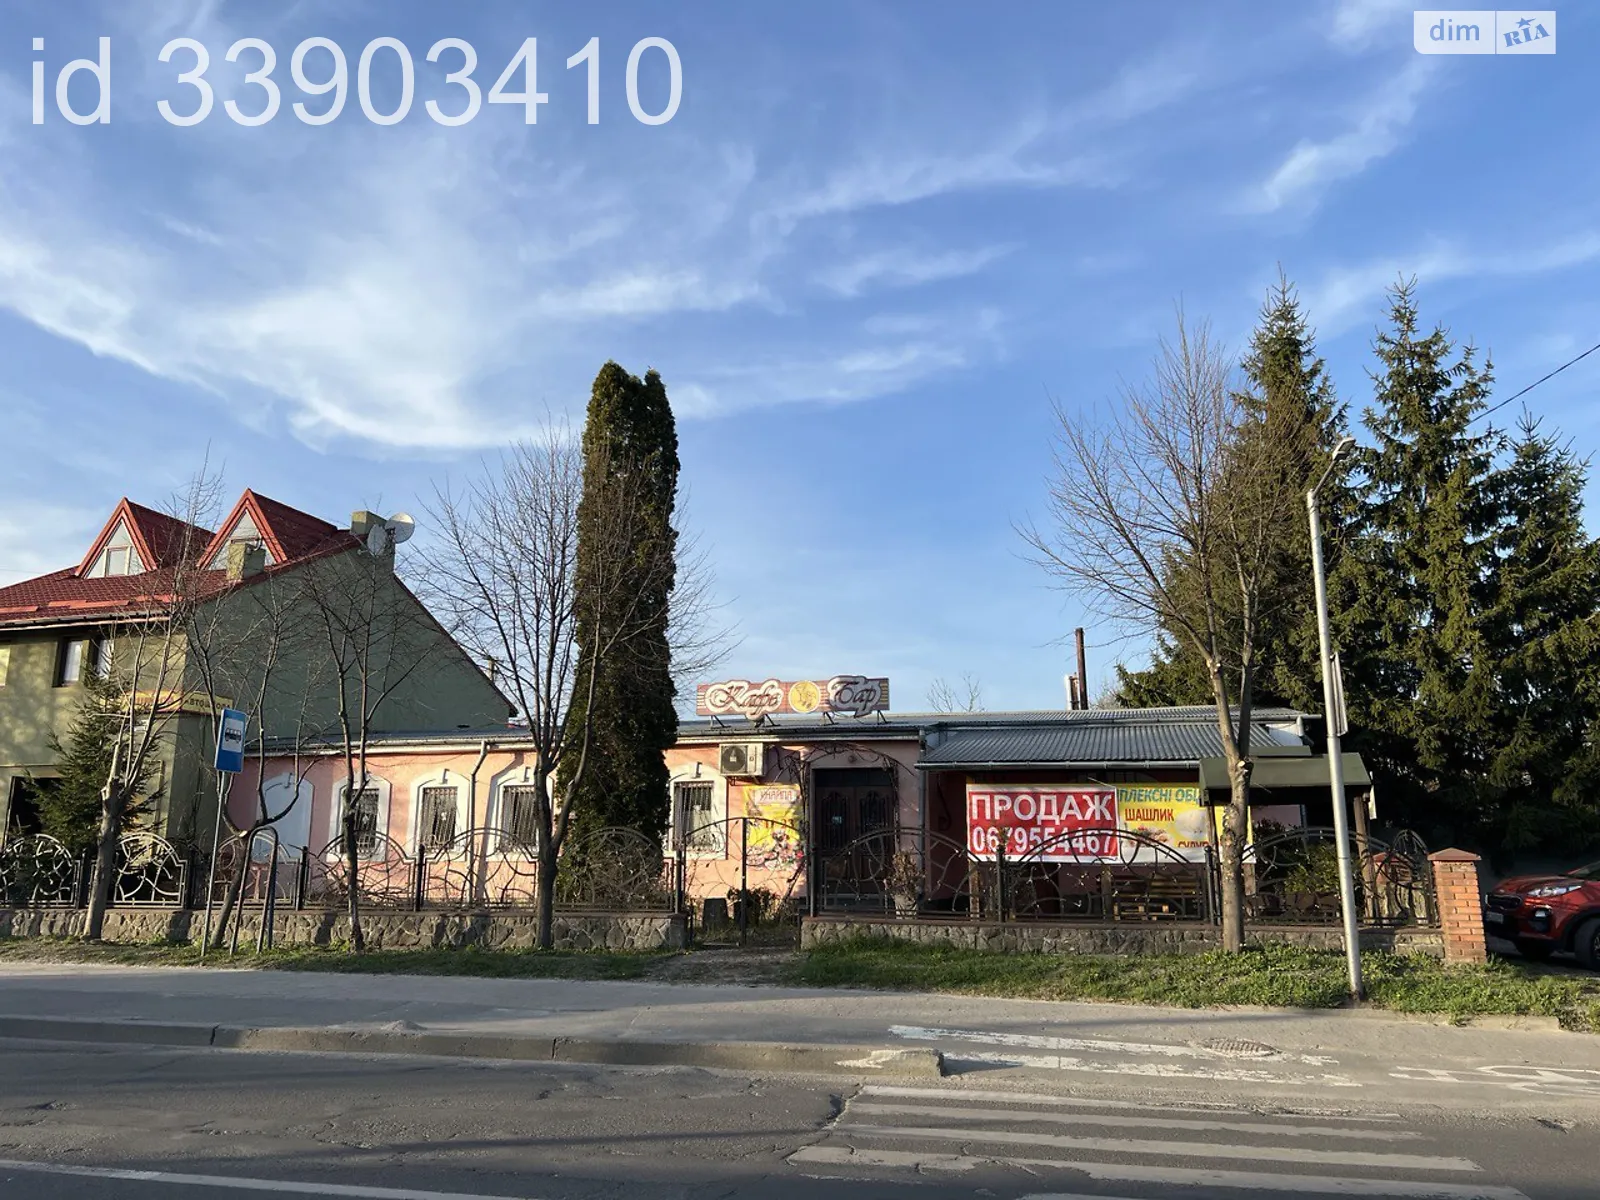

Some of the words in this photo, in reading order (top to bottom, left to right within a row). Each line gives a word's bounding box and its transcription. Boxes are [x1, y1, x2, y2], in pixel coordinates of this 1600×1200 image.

[706, 682, 784, 717] Кафе
[832, 678, 878, 714] Бар
[1117, 788, 1171, 803] ПЛЕКСНІ
[971, 794, 1113, 826] ПРОДАЖ
[1124, 808, 1175, 822] ШАШЛИК
